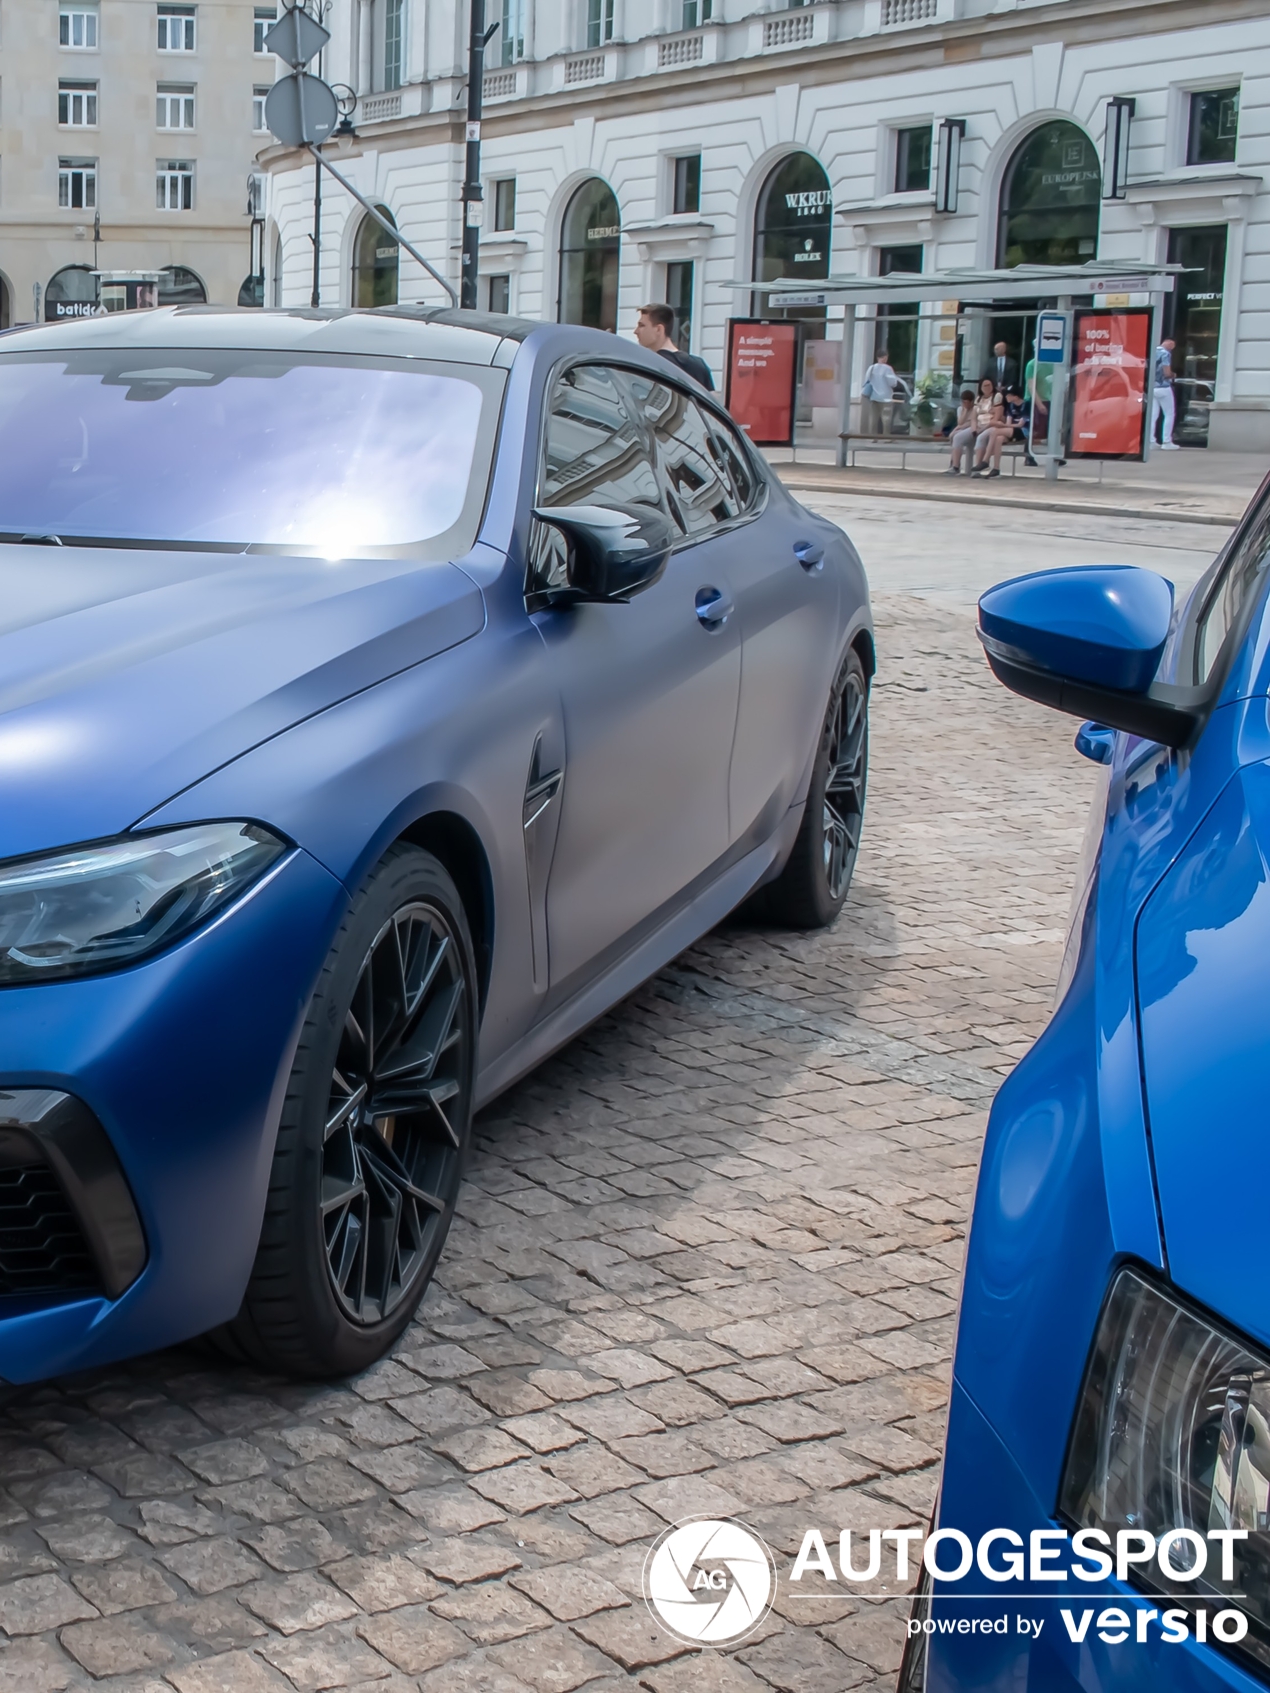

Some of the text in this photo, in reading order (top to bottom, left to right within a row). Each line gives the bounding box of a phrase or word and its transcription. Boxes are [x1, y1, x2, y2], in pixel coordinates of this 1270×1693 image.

[797, 206, 824, 216] 1840
[794, 252, 821, 262] ROLEX
[1086, 330, 1109, 339] 100%
[739, 336, 772, 346] A simple
[1085, 343, 1123, 354] of boring
[738, 359, 754, 367] And
